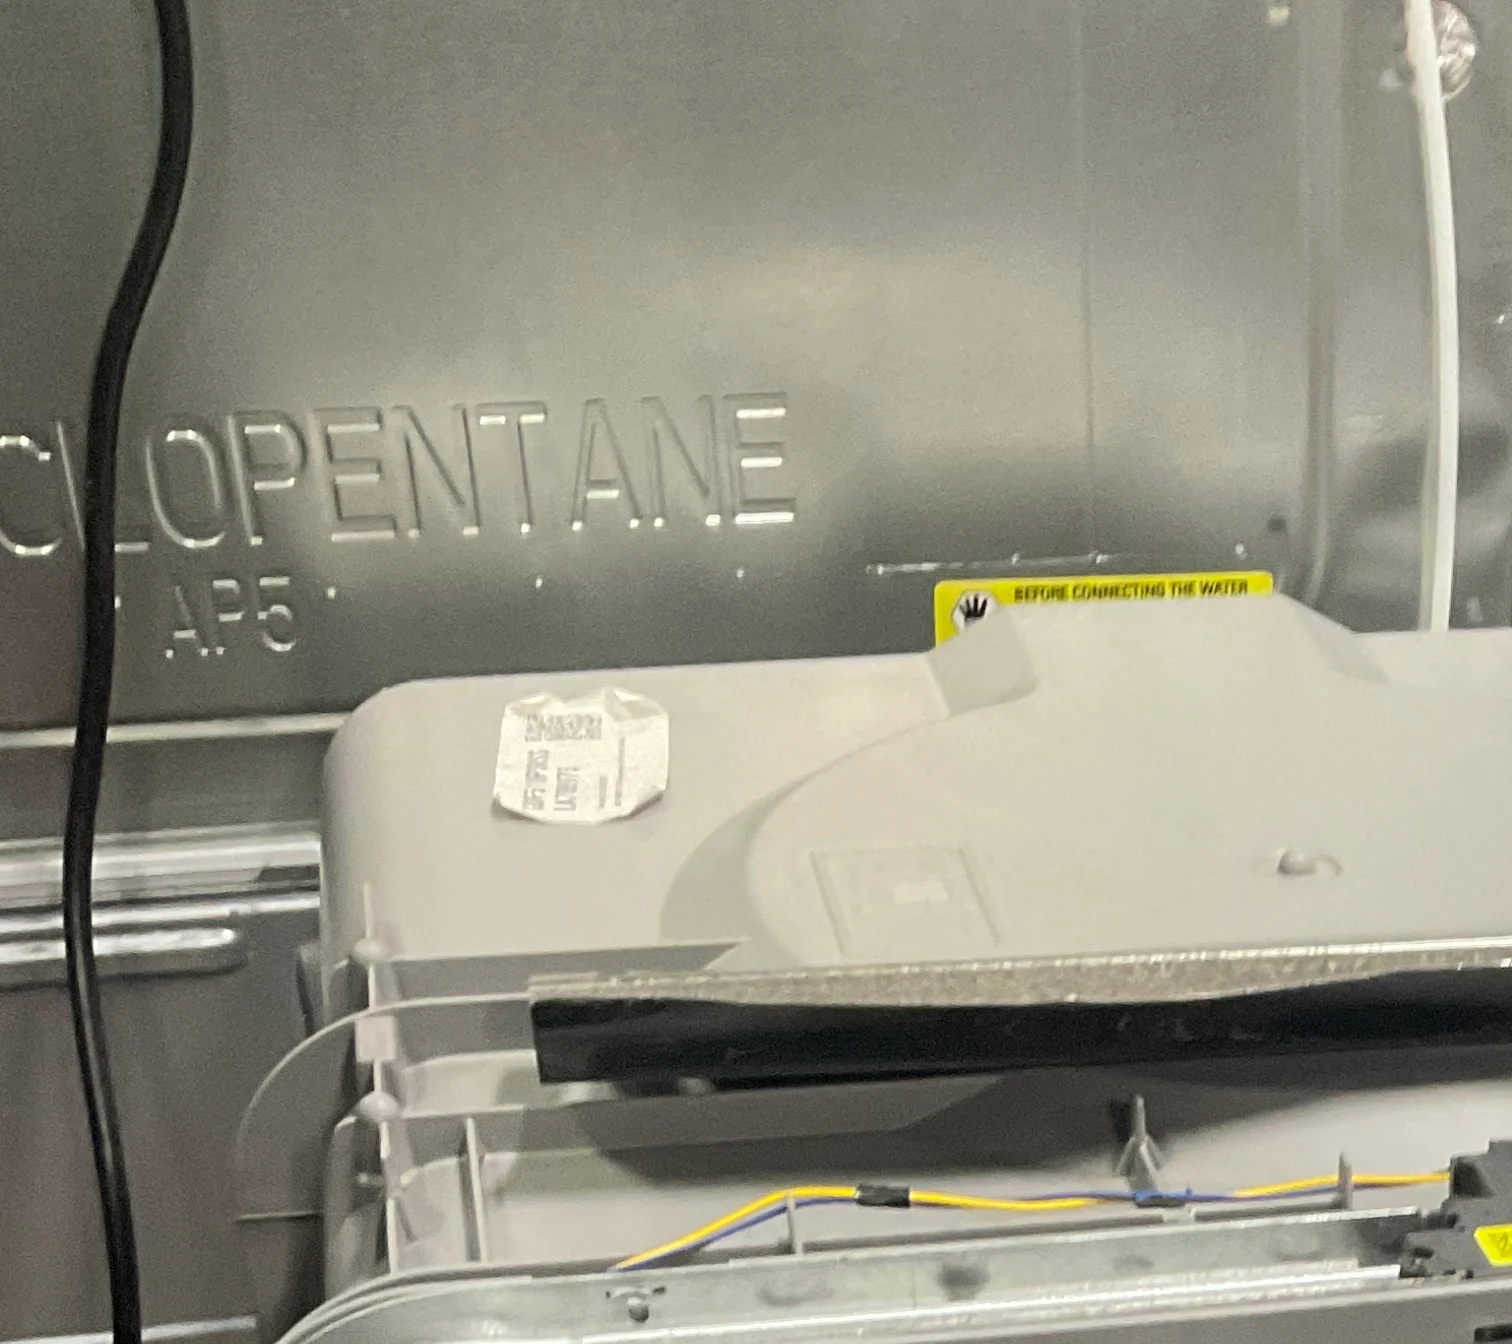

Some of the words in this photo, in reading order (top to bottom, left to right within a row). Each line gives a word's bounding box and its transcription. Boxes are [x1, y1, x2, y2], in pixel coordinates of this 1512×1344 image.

[1013, 583, 1069, 602] BEFORE
[1072, 580, 1165, 600] CONNECTING
[1169, 580, 1197, 599] THE
[1199, 578, 1248, 597] WATER
